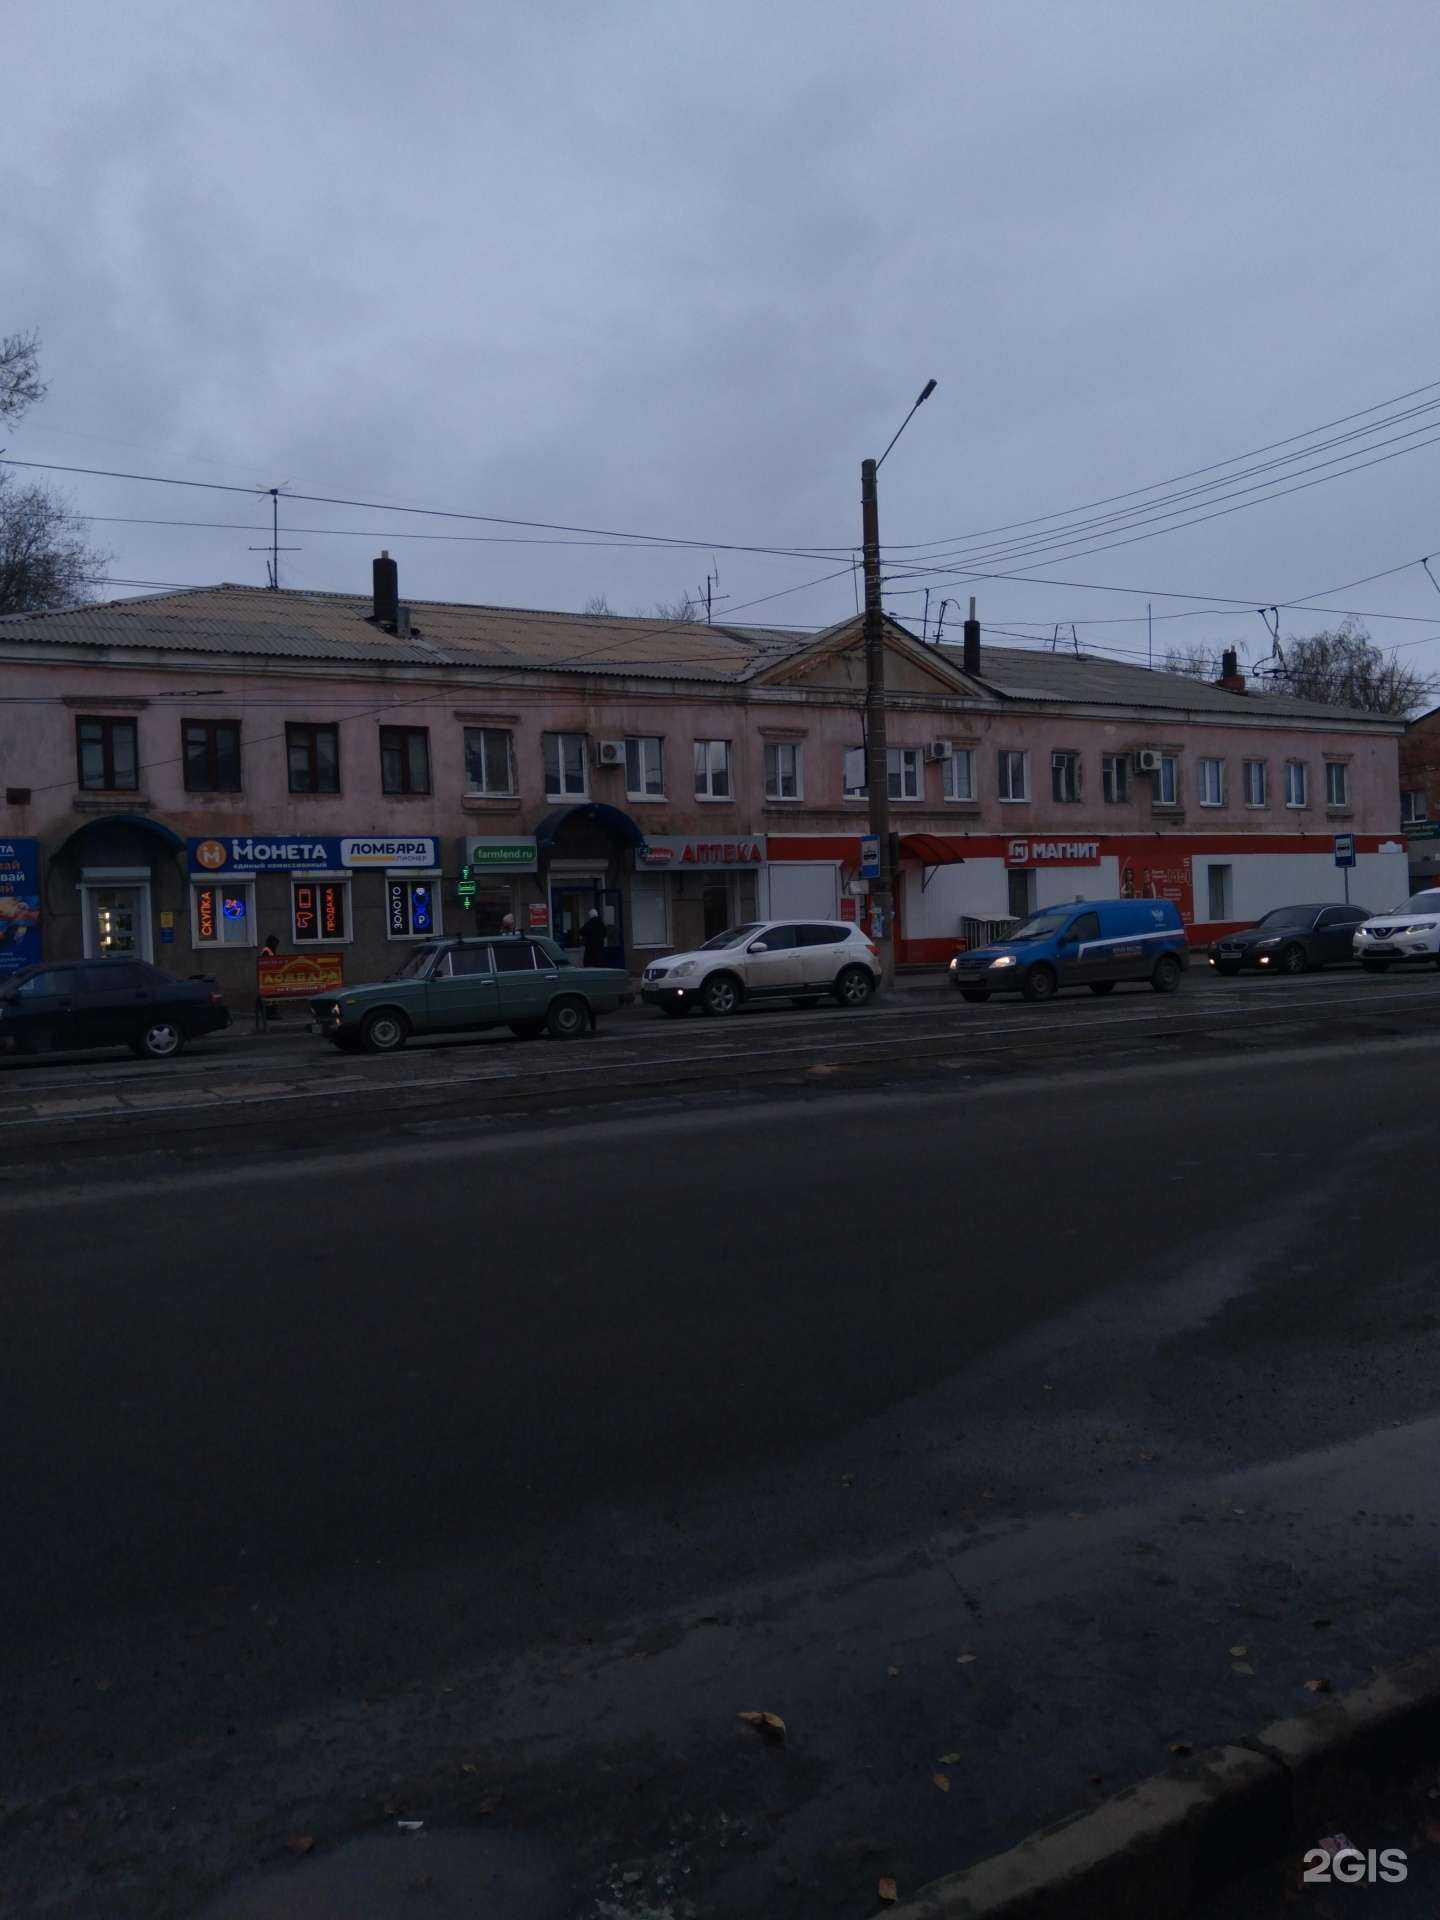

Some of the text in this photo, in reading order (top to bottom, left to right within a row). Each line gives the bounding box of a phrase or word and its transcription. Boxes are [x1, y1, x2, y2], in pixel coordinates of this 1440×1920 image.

[232, 839, 328, 860] МОНЕТА
[350, 843, 427, 855] ЛОМБАРД
[680, 843, 762, 864] АПТЕКА
[1031, 842, 1100, 859] МАГНИТ
[200, 890, 213, 936] СКУПКА
[325, 886, 336, 932] ПРОДАЖА
[391, 886, 403, 929] ЗОЛОТО
